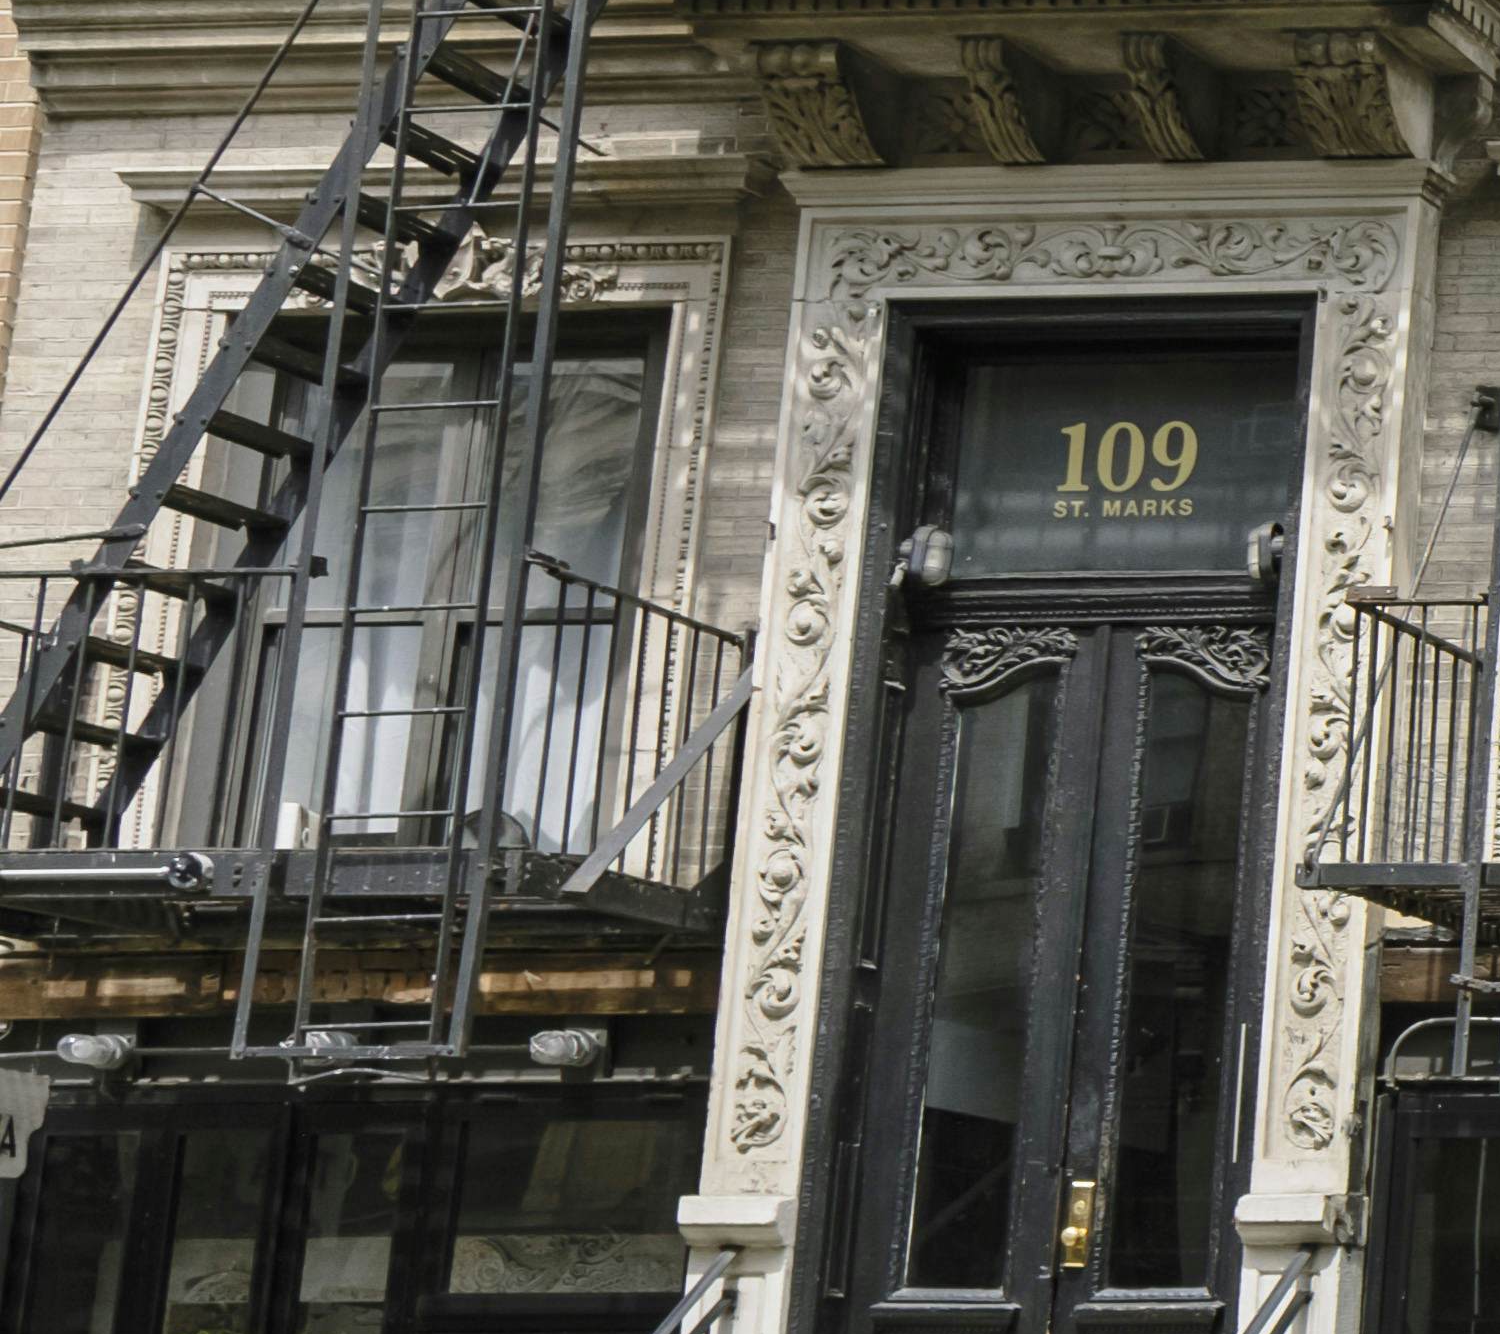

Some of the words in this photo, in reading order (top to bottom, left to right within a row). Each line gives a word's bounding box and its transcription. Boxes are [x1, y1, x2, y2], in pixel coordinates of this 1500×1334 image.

[1056, 420, 1198, 492] 109
[1053, 500, 1089, 517] ST.
[1103, 499, 1193, 517] MARKS
